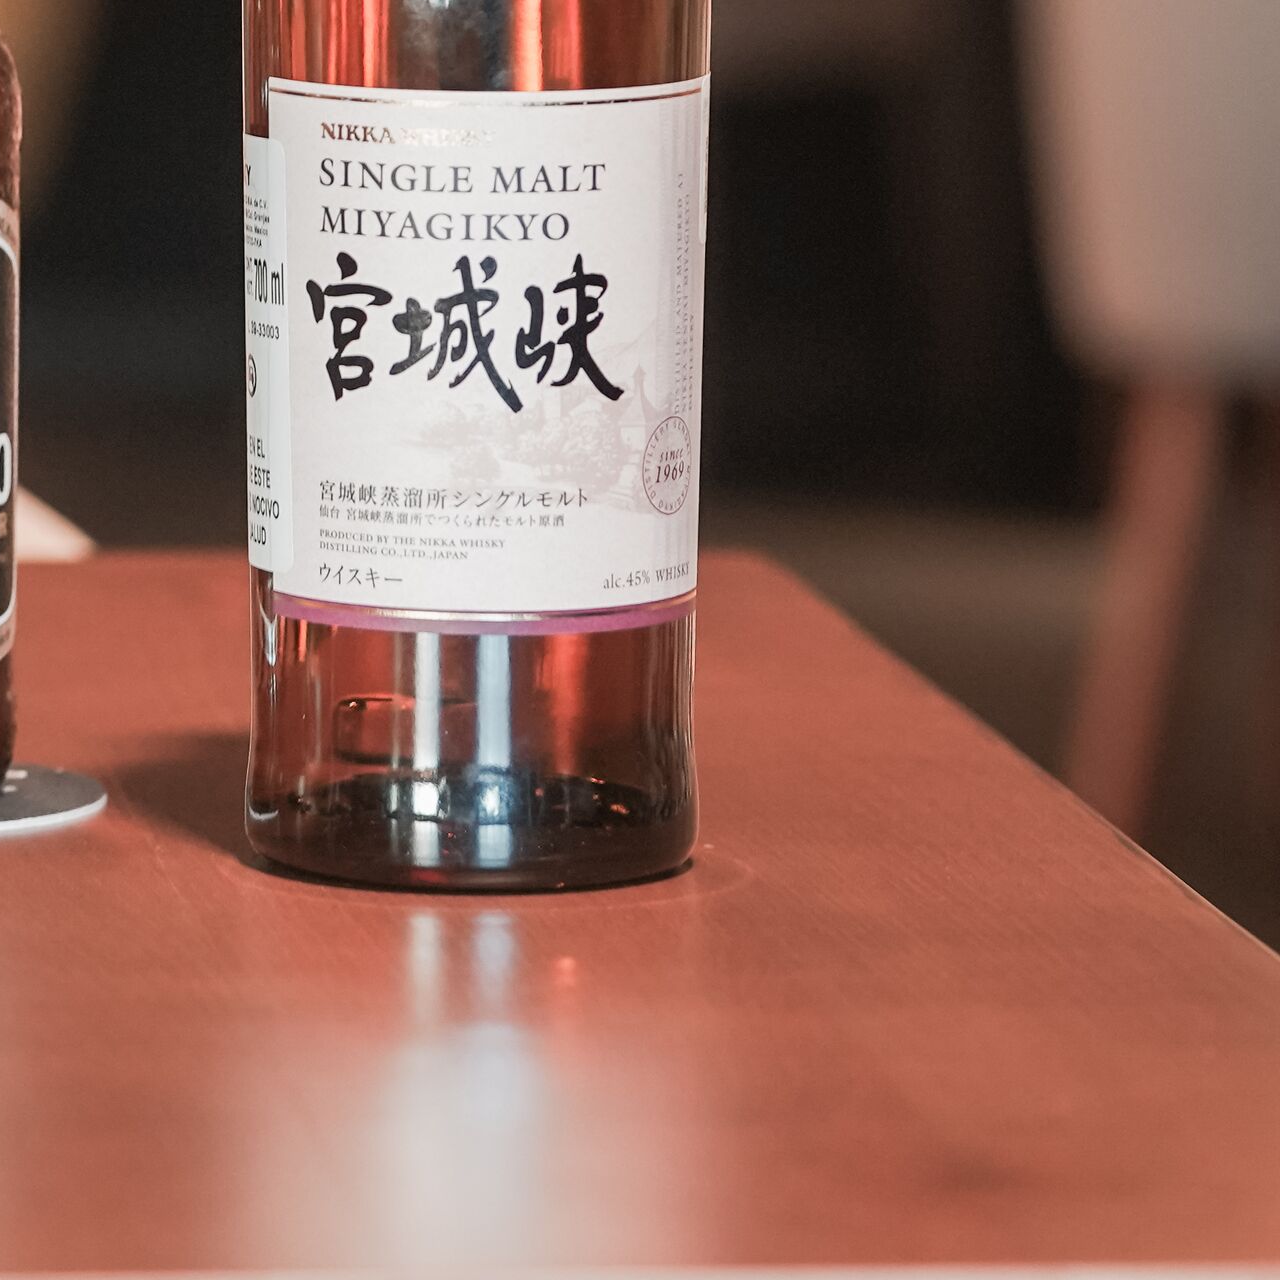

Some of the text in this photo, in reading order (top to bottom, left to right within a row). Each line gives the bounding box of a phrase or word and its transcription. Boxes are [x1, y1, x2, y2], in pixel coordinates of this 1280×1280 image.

[321, 122, 396, 144] NIKKA
[319, 157, 606, 193] SINGLE MALT
[319, 205, 570, 241] MIYAGIKYO
[254, 257, 268, 304] 700
[271, 261, 285, 306] ml
[306, 252, 624, 413] 宮城峡
[257, 438, 266, 458] EL
[659, 447, 684, 464] since
[254, 465, 271, 488] ESTE
[656, 460, 685, 484] 1969
[252, 493, 280, 519] NOCIVO
[319, 480, 588, 510] 宮城峡蒸溜所シングルモルト
[319, 504, 339, 520] 仙台
[319, 529, 505, 549] PRODUCED BY THE NIKKA WHISKY
[319, 540, 377, 555] DISTILLING
[319, 563, 403, 588] ウイスキー
[603, 561, 690, 589] alc.45% WHISKY
